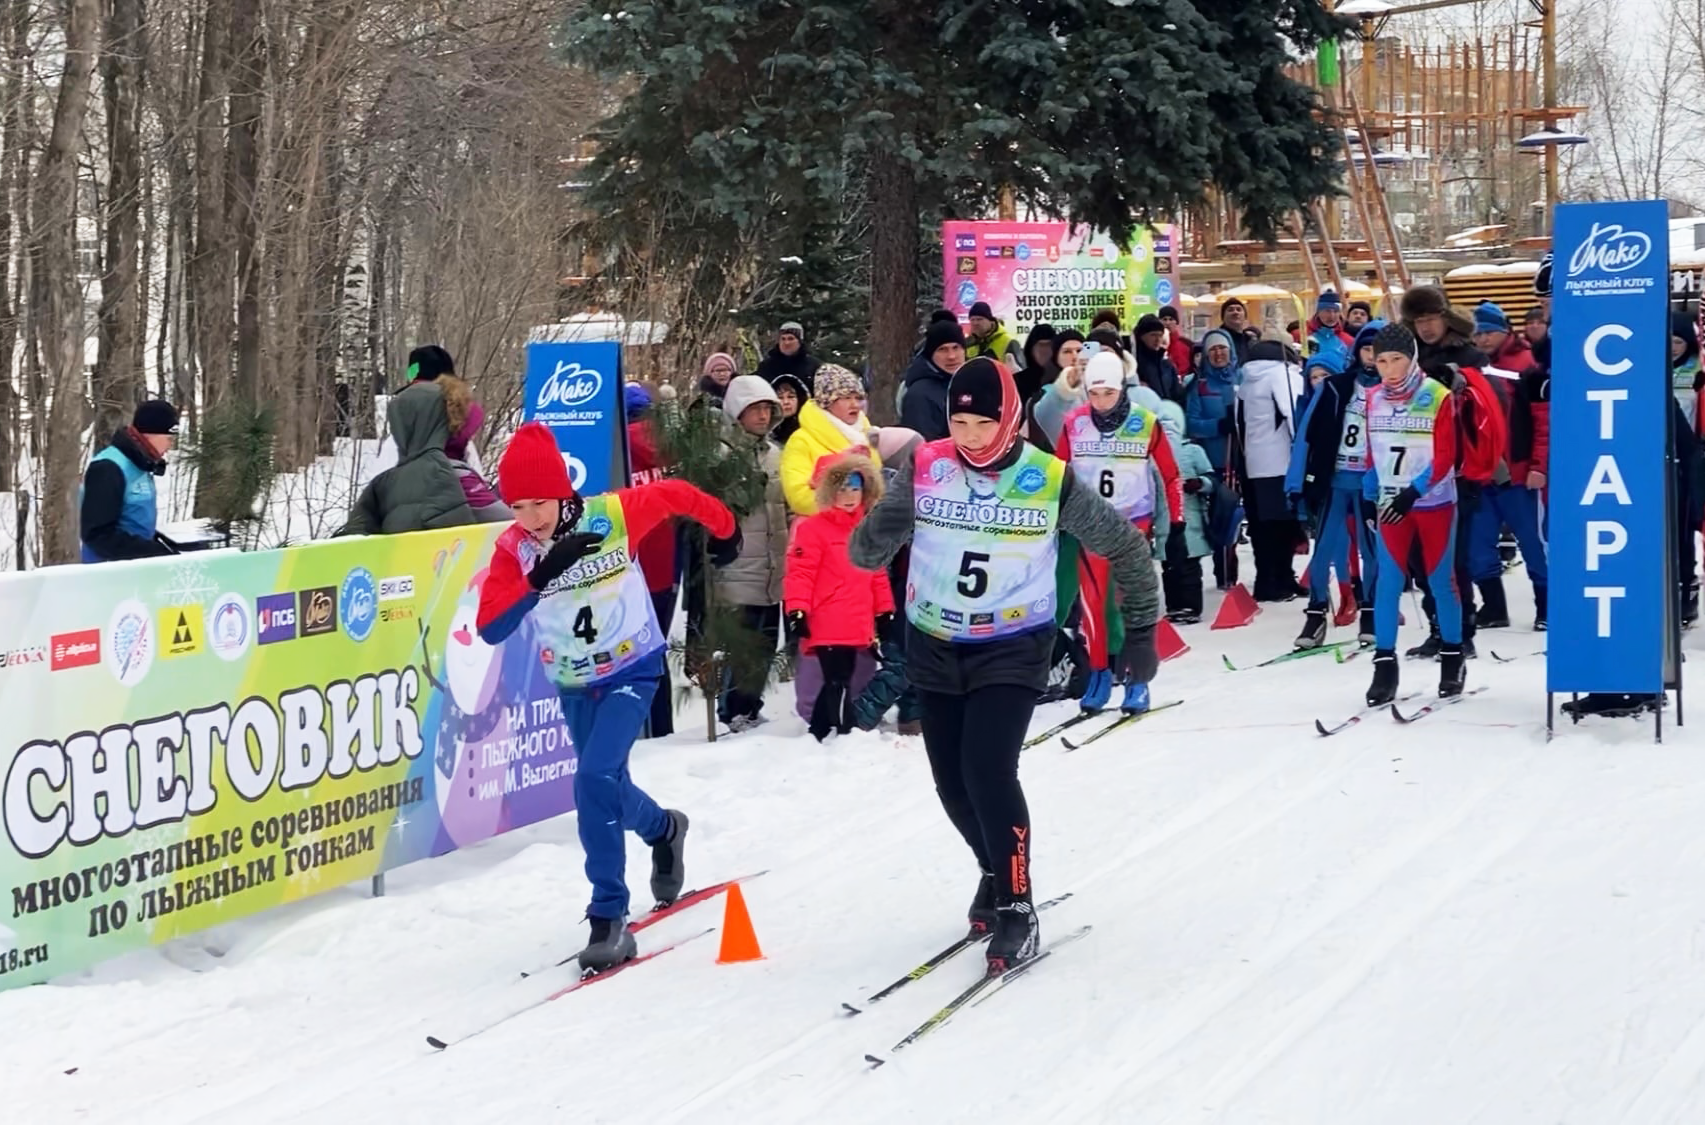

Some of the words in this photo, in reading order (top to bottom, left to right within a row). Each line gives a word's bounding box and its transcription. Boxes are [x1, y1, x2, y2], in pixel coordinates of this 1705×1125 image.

[1012, 268, 1127, 293] СНЕГОВИК
[1564, 276, 1621, 289] ЛЫЖНЫЙ
[1623, 278, 1654, 287] КЛУБ
[1016, 294, 1125, 307] многоэтапные
[1016, 307, 1125, 324] соревновая
[533, 410, 577, 420] ЛЫЖНЫЙ
[578, 411, 603, 420] КЛУБ
[1344, 424, 1360, 448] 8
[1390, 446, 1407, 476] 7
[1099, 469, 1115, 498] 6
[1579, 324, 1633, 638] СТАРТ
[917, 495, 1048, 528] СНЕГОВИК
[957, 550, 990, 599] 5
[272, 609, 295, 626] ПСБ
[572, 605, 598, 645] 4
[506, 704, 527, 732] НА
[531, 696, 565, 726] ПРИ
[3, 665, 424, 859] СНЕГОВИК
[482, 727, 558, 769] ЛЫЖНОГО
[12, 827, 243, 918] многоэтапные
[251, 777, 424, 849] соревнования
[88, 900, 128, 938] по
[137, 855, 276, 922] лыжным
[285, 826, 375, 876] гонкам
